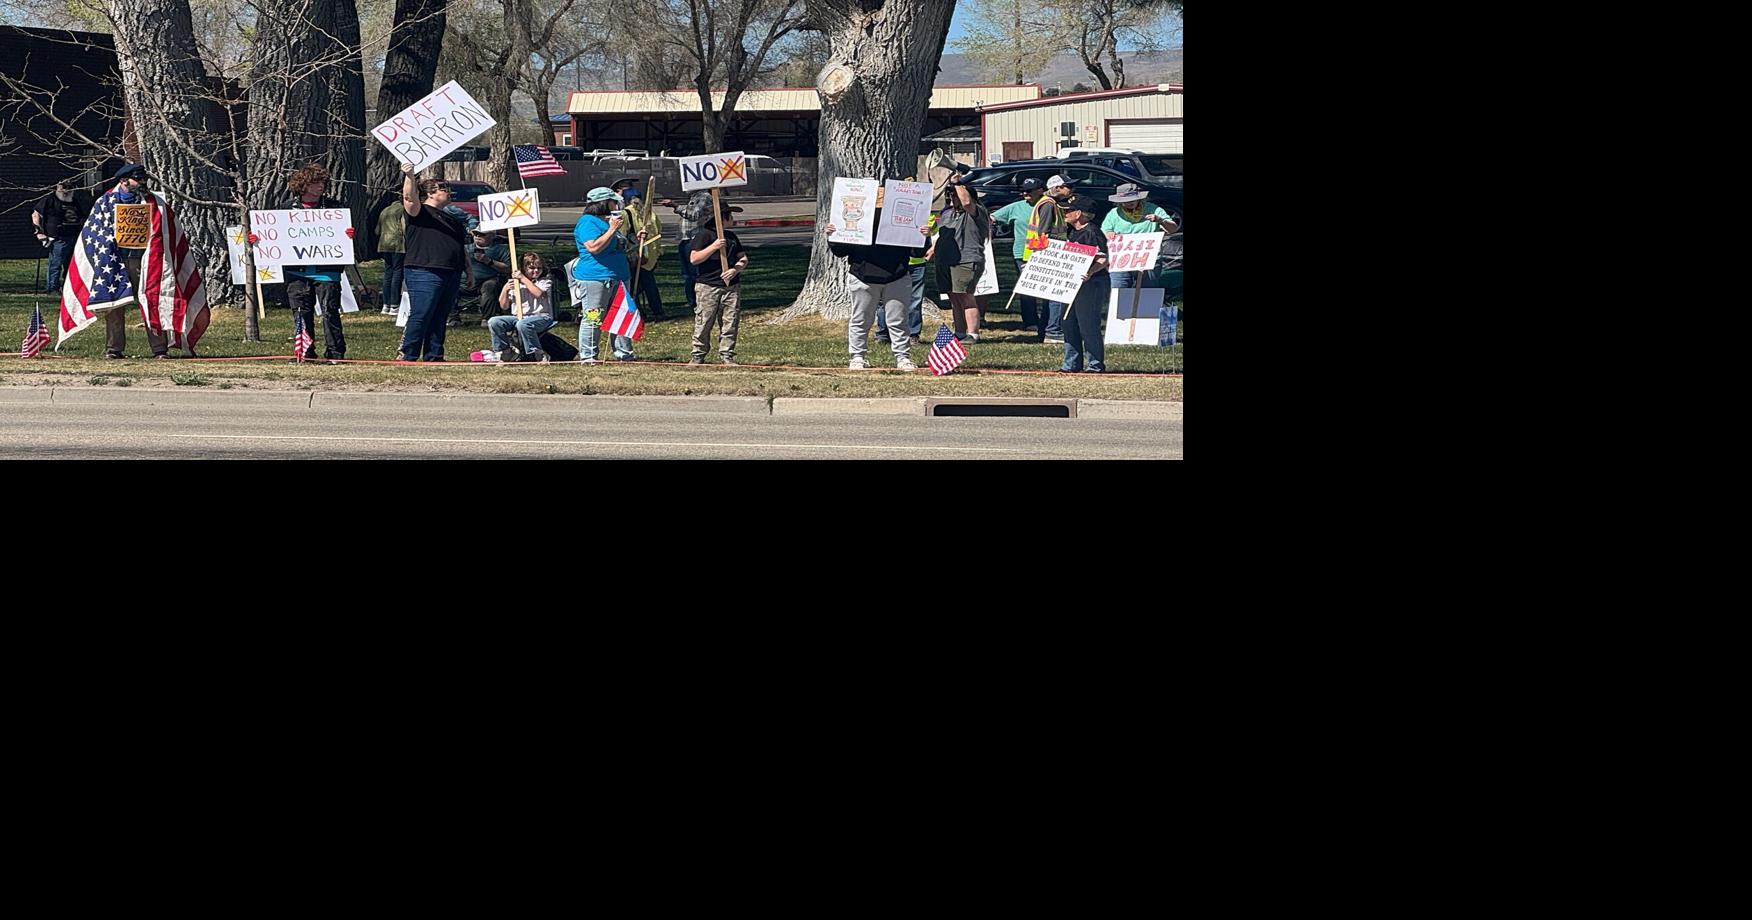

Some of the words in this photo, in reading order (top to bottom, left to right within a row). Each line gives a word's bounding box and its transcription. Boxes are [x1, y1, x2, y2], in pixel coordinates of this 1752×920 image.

[377, 87, 456, 143] DRAFT
[394, 101, 488, 166] BARRON
[682, 162, 717, 183] NO
[119, 208, 136, 217] No
[255, 212, 277, 225] NO
[288, 210, 344, 223] KINGS
[479, 200, 505, 221] NO
[117, 216, 149, 226] Kings
[117, 225, 148, 234] Since
[257, 228, 278, 241] NO
[288, 226, 335, 239] CAMPS
[119, 234, 147, 243] 1776
[257, 246, 282, 260] NO
[292, 245, 344, 260] WARS
[1043, 249, 1060, 258] TOOK
[1070, 255, 1087, 264] OATH
[1038, 257, 1061, 268] DEFEND
[1061, 262, 1074, 271] THE
[1029, 274, 1054, 286] BELIEVE
[1054, 278, 1063, 286] IN
[1064, 281, 1078, 290] THE
[1039, 284, 1048, 292] OF
